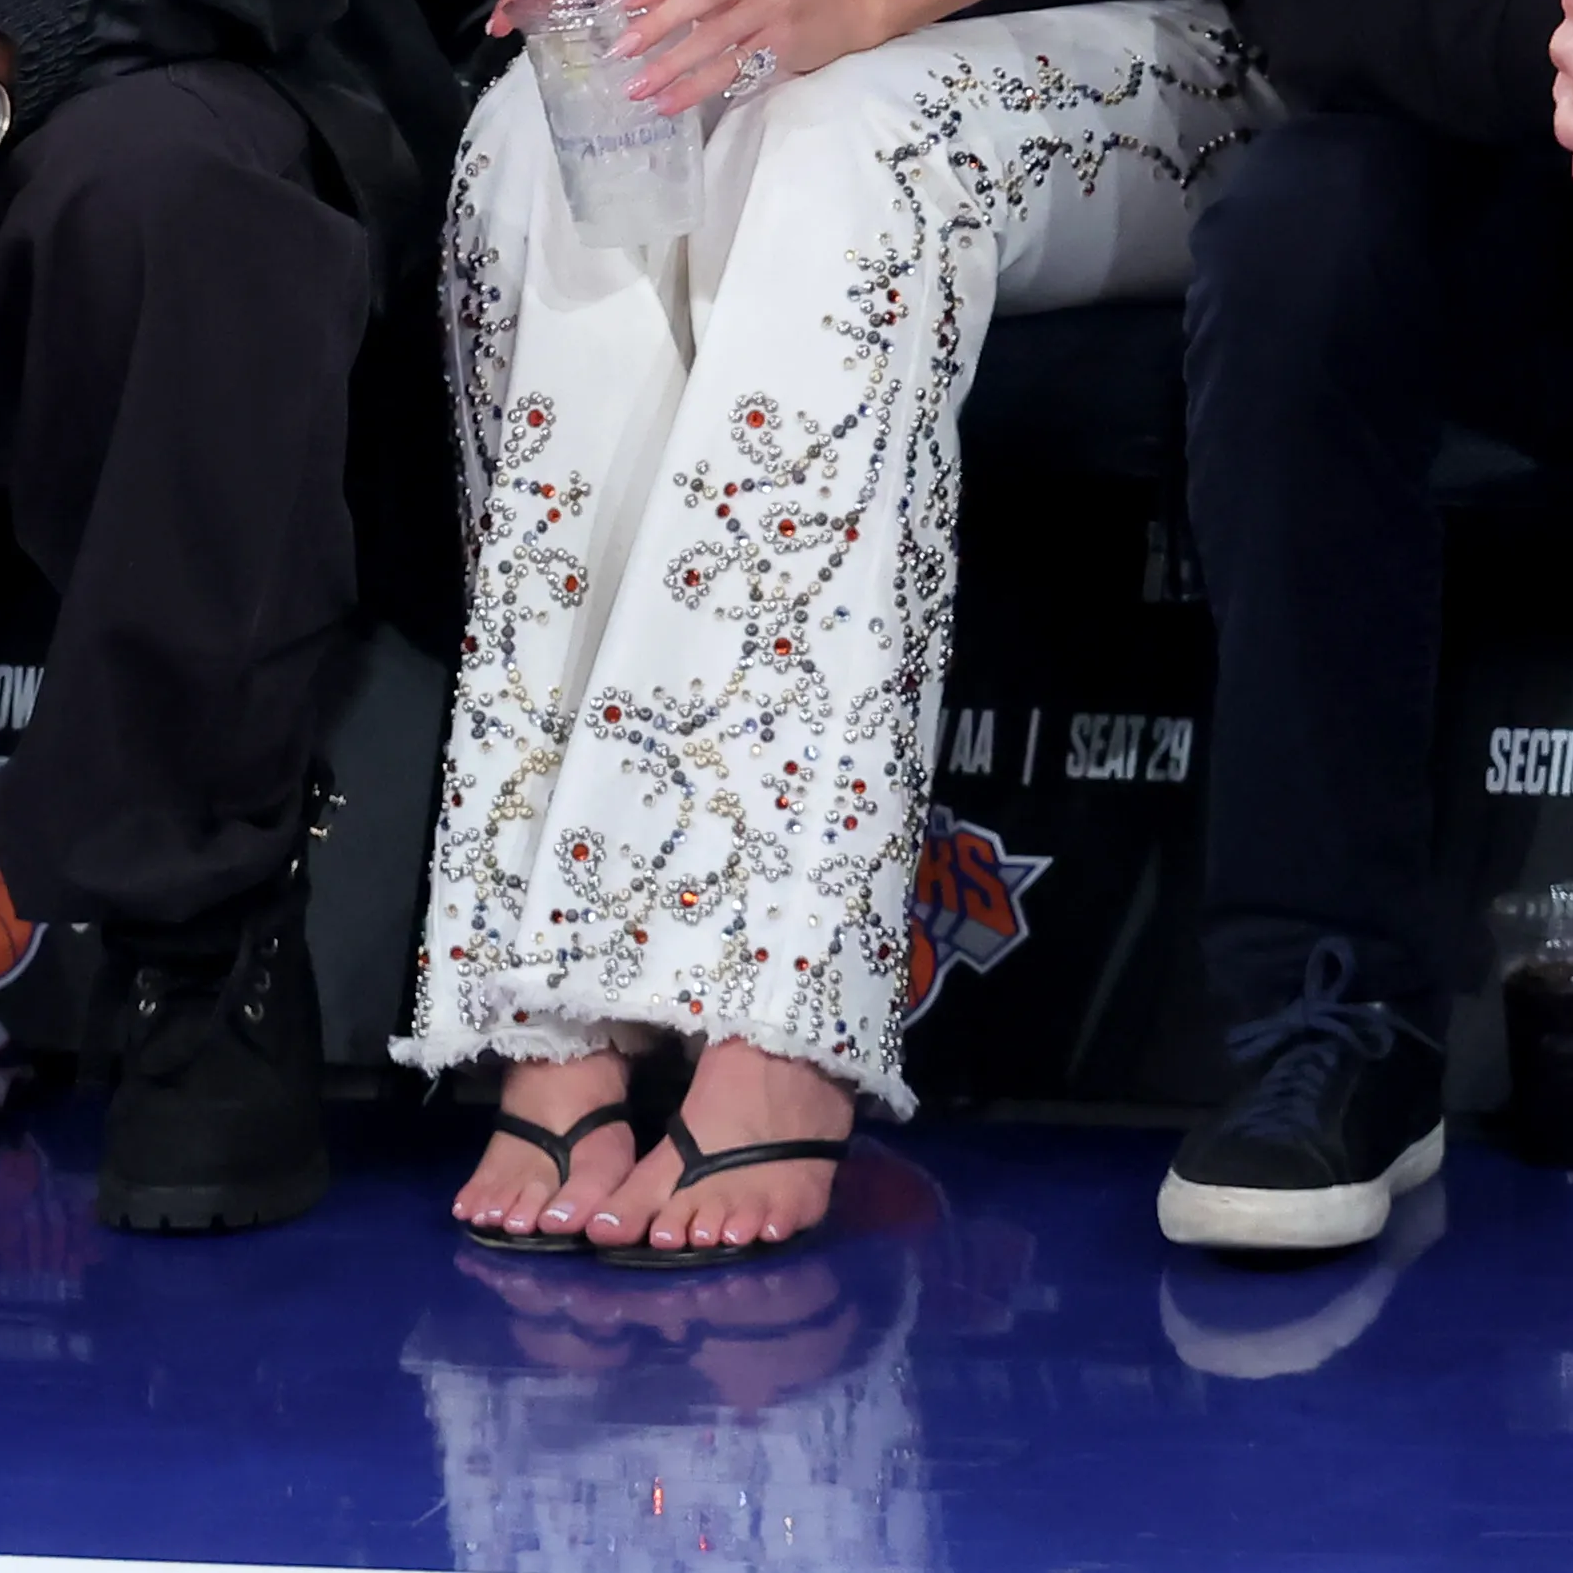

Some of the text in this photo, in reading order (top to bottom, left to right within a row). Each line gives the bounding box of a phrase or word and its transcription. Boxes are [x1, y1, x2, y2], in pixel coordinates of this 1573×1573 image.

[947, 707, 1195, 783] AA SEAT 29
